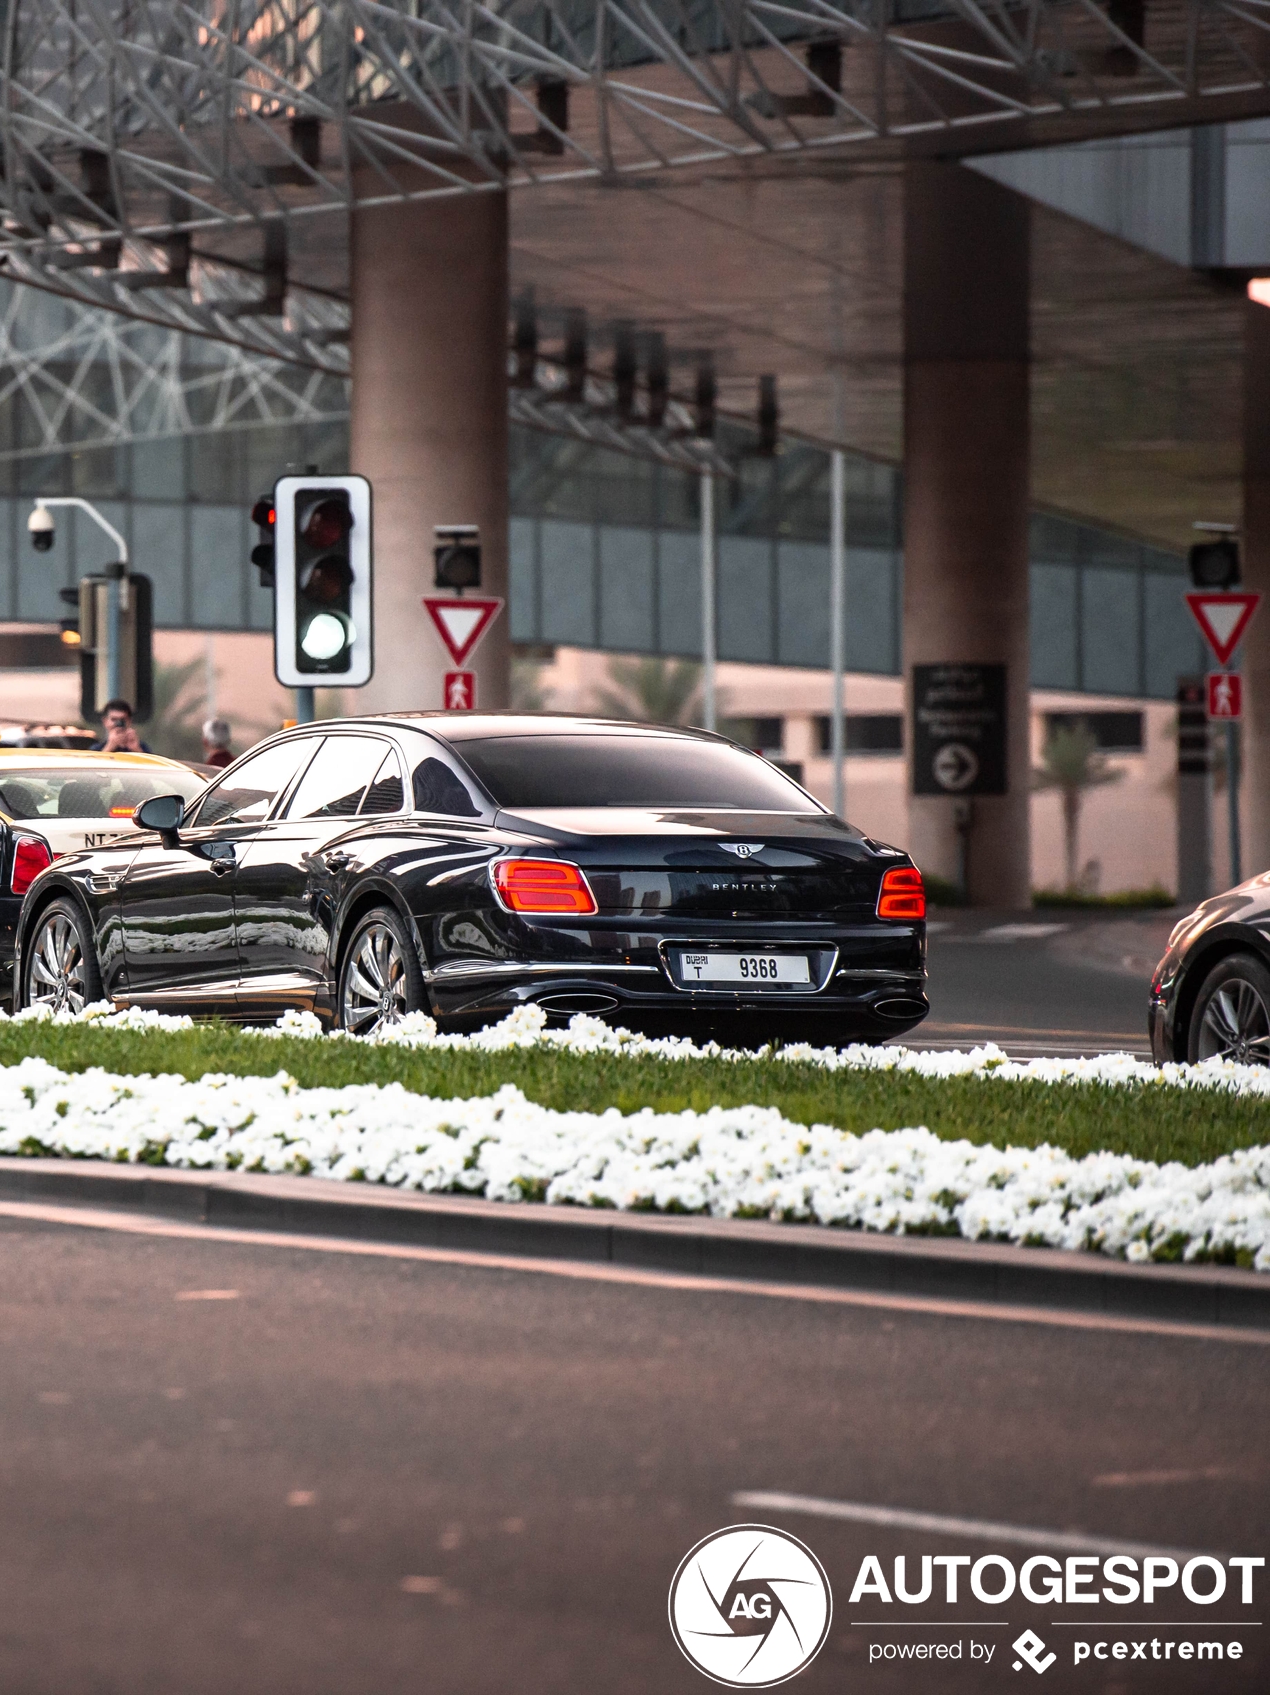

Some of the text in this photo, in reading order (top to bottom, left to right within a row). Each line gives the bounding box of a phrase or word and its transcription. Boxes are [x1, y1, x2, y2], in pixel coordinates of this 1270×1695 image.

[712, 883, 778, 892] BENTLEY
[694, 967, 703, 979] T
[740, 958, 778, 979] 9368
